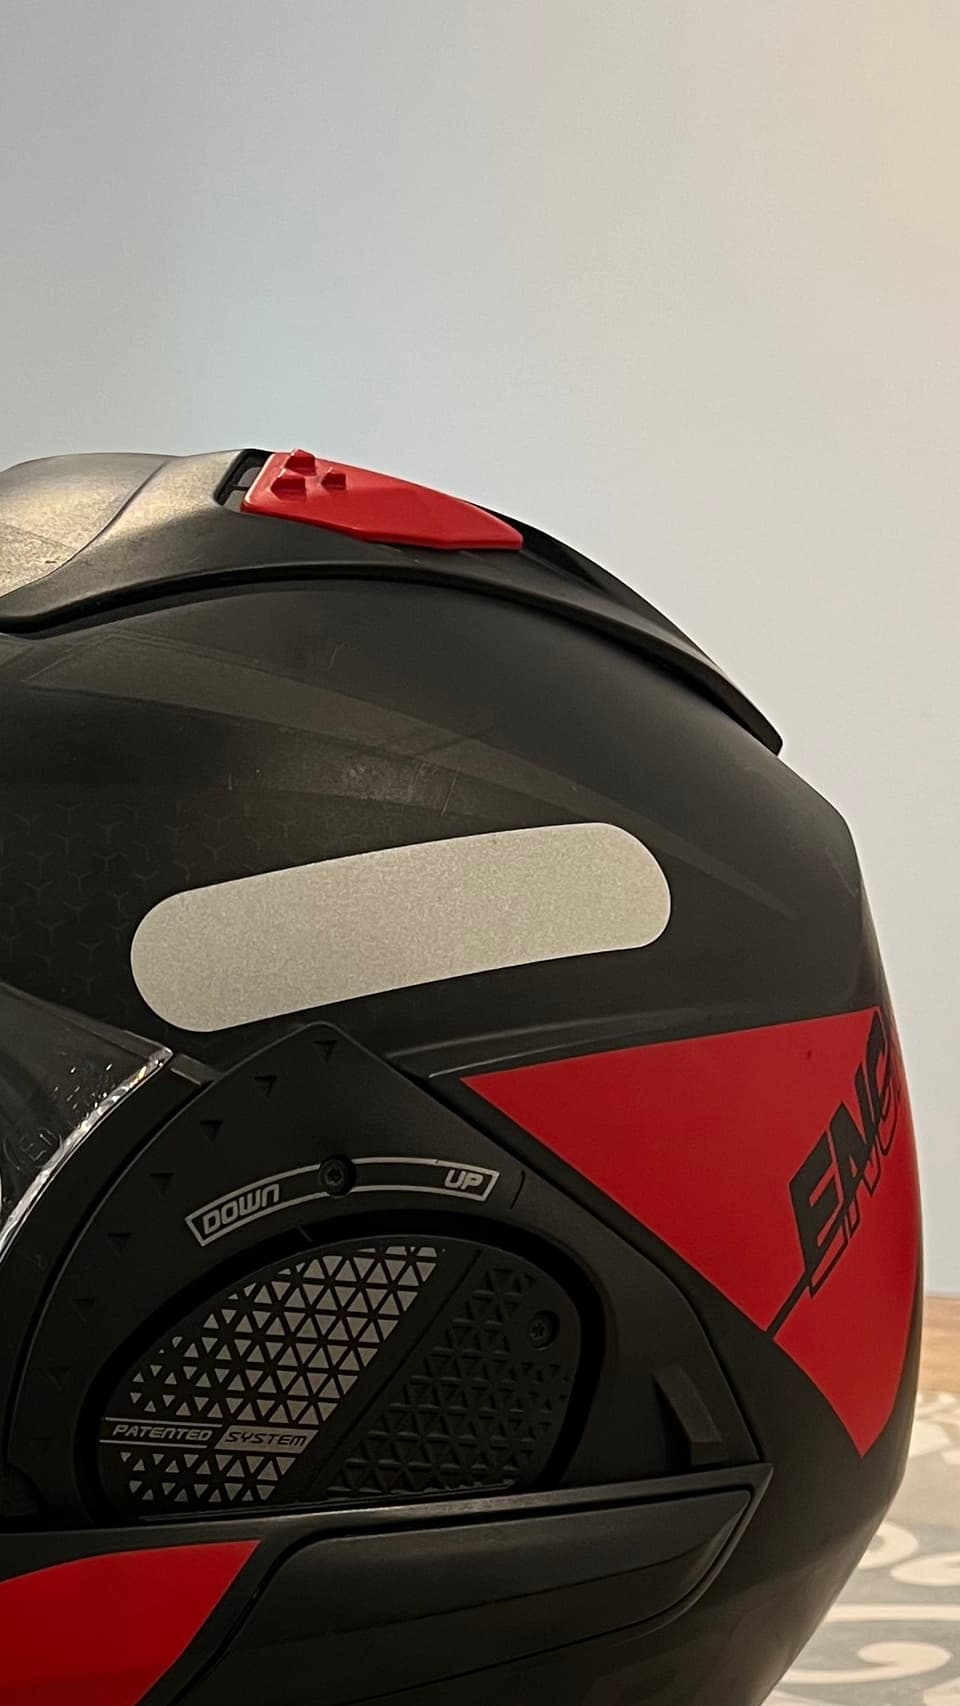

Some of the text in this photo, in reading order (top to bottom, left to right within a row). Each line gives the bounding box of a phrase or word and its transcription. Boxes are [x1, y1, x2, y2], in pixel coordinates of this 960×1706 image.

[202, 1169, 484, 1235] DOWN UP
[112, 1424, 308, 1447] PATENTED SYSTEM
